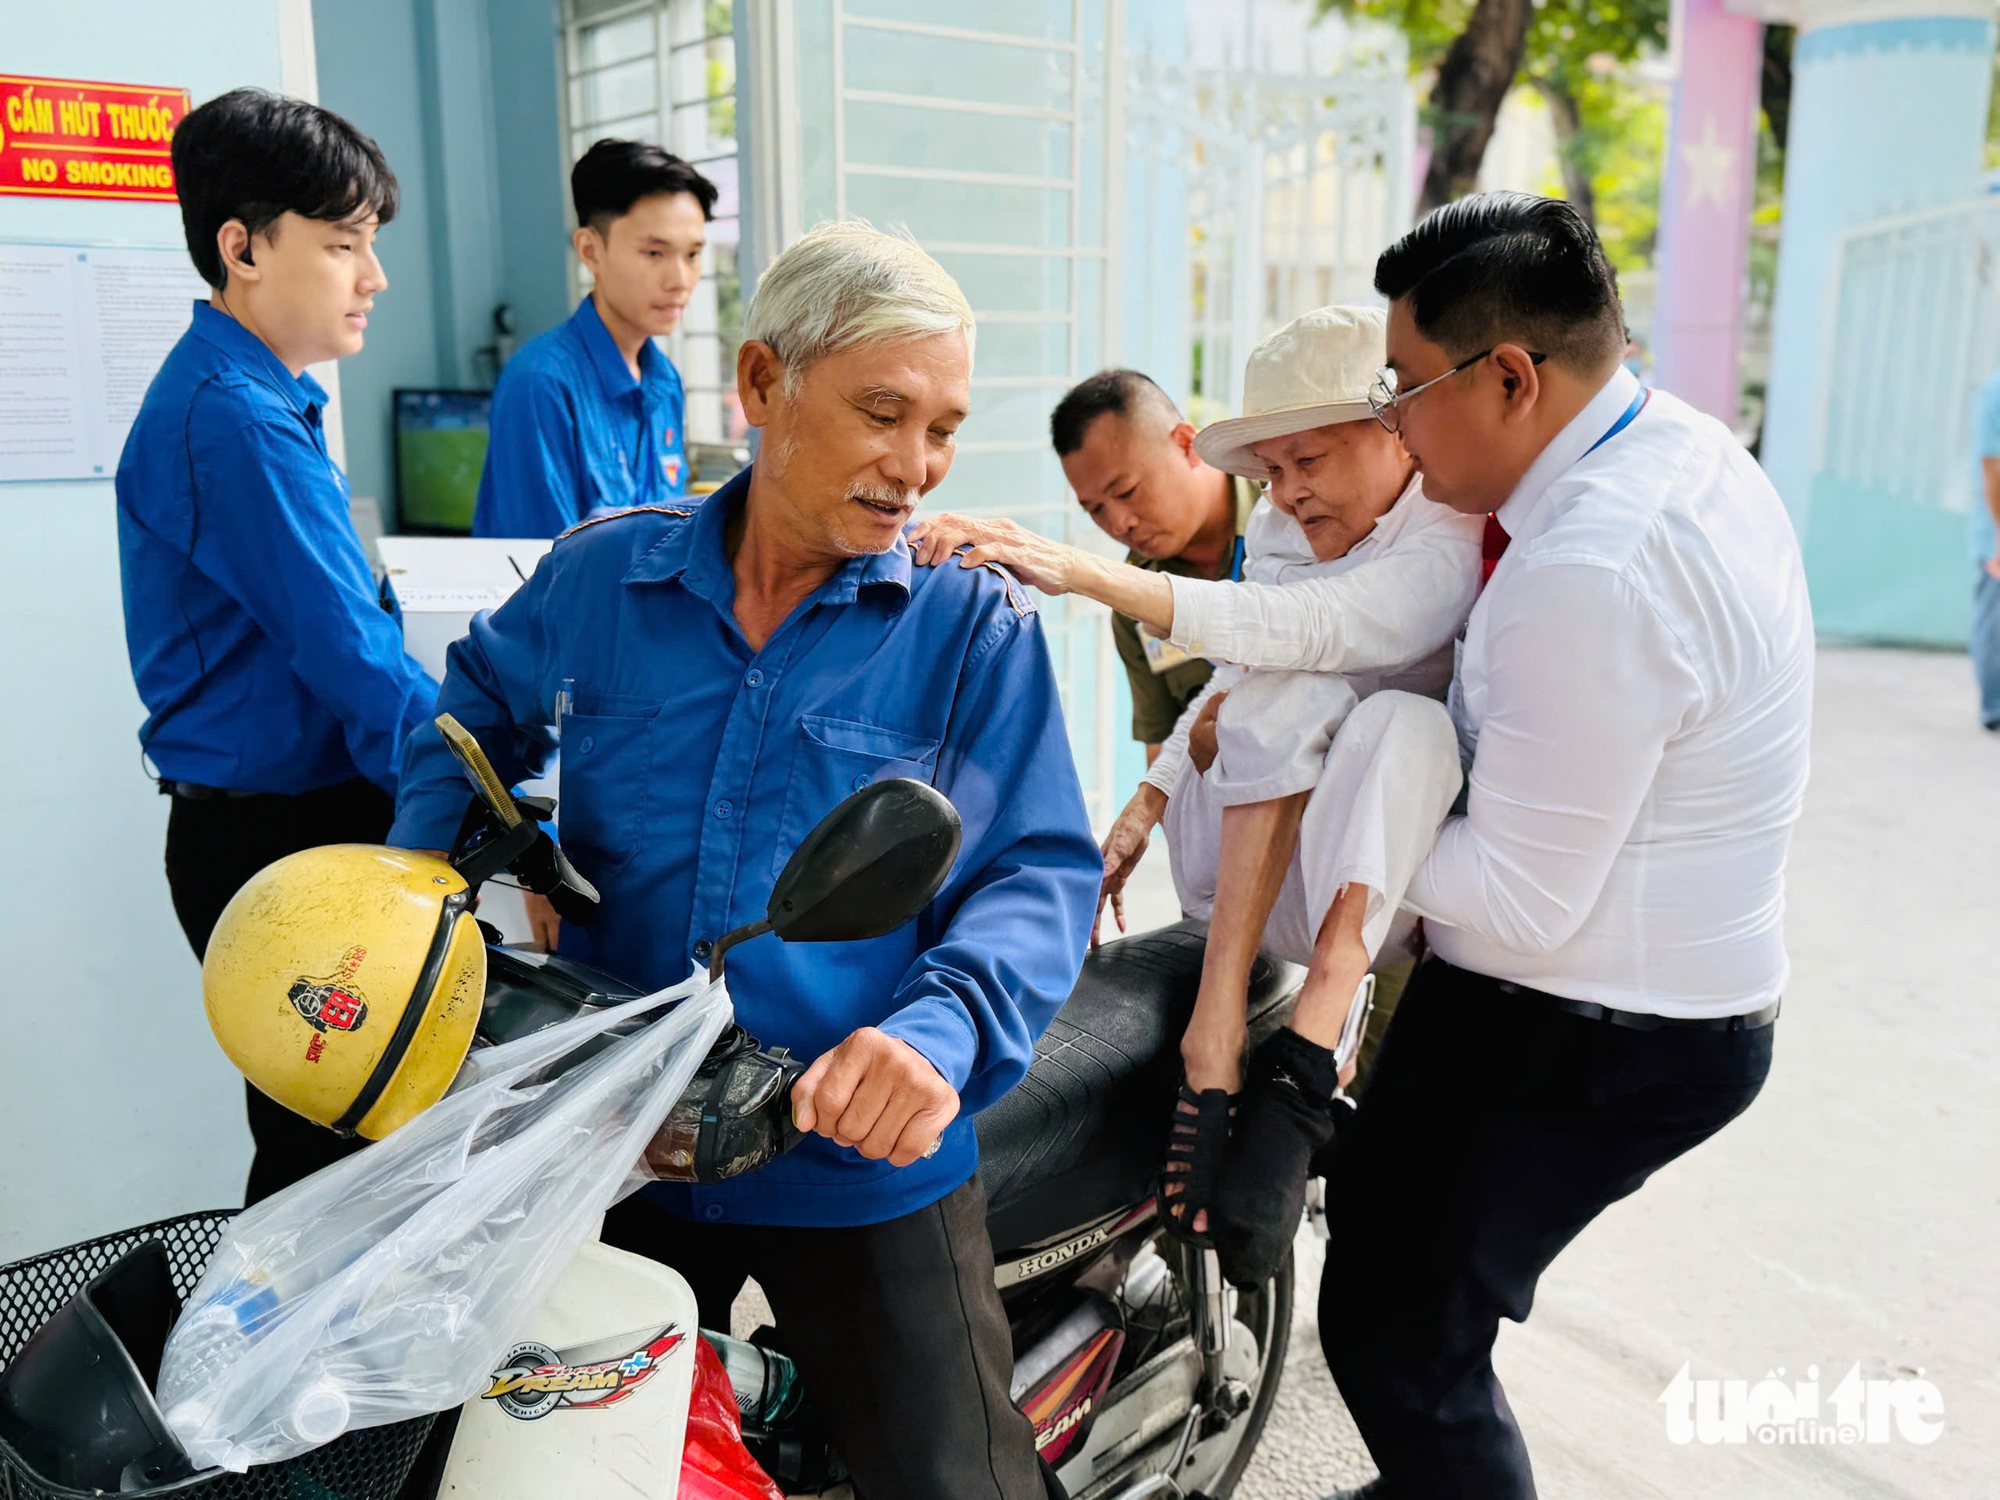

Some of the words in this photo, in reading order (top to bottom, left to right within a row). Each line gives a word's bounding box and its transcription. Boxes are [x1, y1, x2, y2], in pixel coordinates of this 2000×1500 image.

[7, 85, 54, 134] CẤM
[59, 92, 101, 137] HÚT
[106, 95, 174, 142] THUỐC
[22, 157, 58, 182] NO
[65, 160, 173, 188] SMOKING
[1019, 1227, 1108, 1278] HONDA
[507, 1345, 546, 1359] FAMILY
[481, 1366, 619, 1399] DREAM
[506, 1400, 553, 1416] VEHICLE
